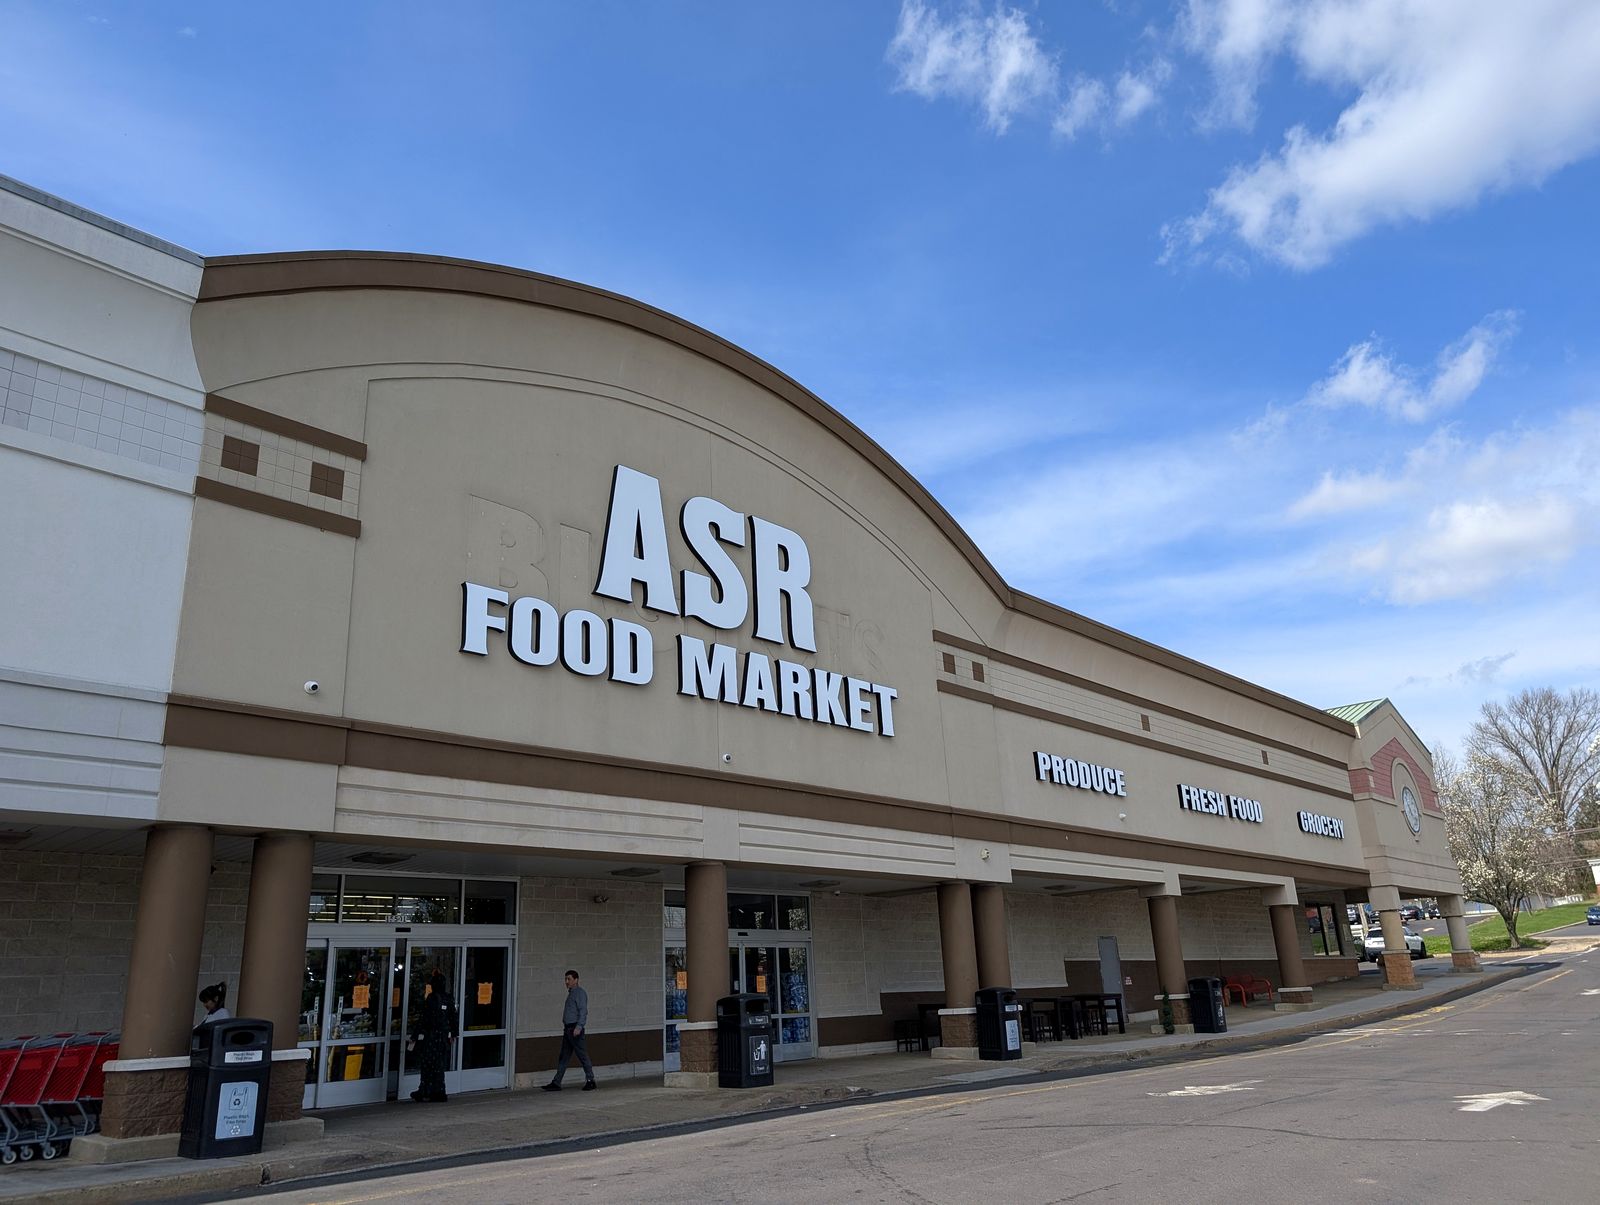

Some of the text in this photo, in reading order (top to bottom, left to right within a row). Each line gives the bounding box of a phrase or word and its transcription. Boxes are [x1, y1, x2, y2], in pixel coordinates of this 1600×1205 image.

[593, 464, 817, 653] ASR
[459, 580, 655, 686] FOOD
[676, 633, 898, 737] MARKET
[1032, 751, 1127, 797] PRODUCE
[1176, 783, 1264, 824] FRESH FOOD
[1297, 810, 1345, 839] GROCERY
